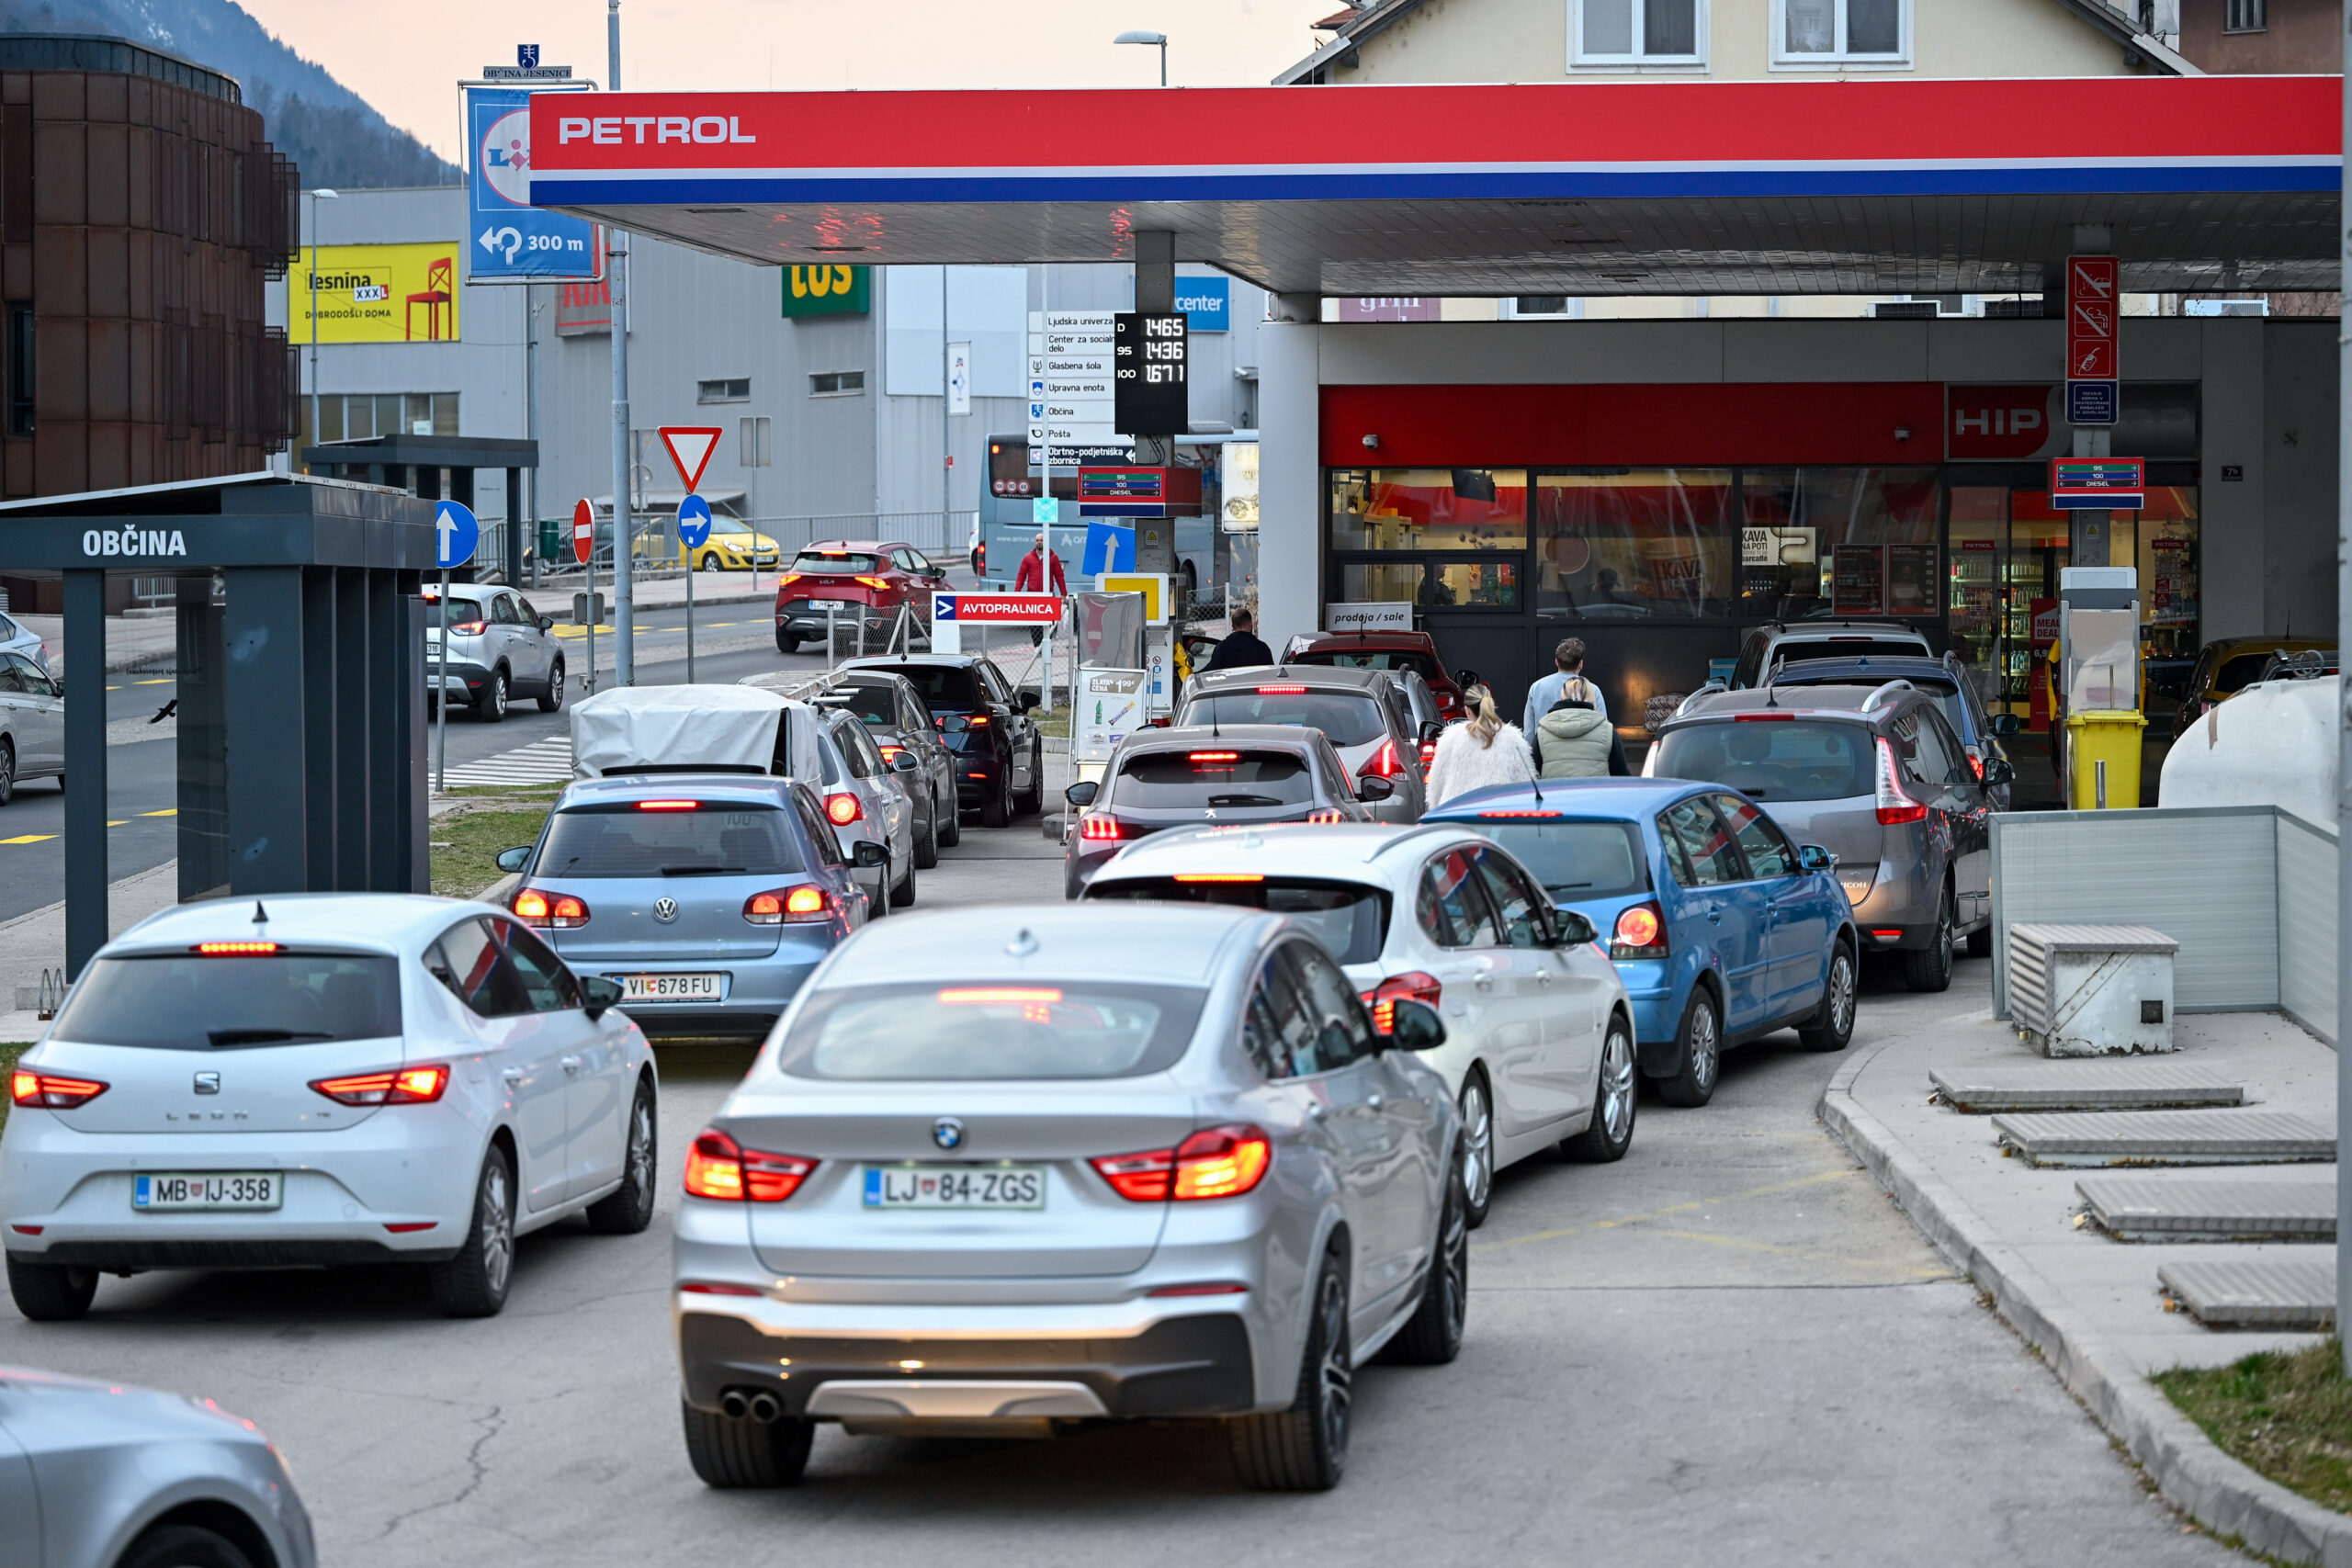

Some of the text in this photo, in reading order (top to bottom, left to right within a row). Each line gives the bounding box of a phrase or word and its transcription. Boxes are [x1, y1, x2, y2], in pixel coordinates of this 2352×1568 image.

[524, 69, 571, 78] JESENICE
[560, 117, 756, 144] PETROL
[528, 235, 583, 251] 300 m
[309, 272, 371, 289] lesnina
[356, 287, 388, 299] XXXL
[1175, 295, 1224, 311] center
[365, 309, 391, 318] DOMA
[1048, 317, 1114, 327] Ljudska univerza
[1117, 323, 1125, 332] D
[1048, 334, 1074, 344] Center
[1090, 334, 1115, 344] socialn
[1048, 344, 1064, 353] delo
[1117, 346, 1132, 355] 95
[1048, 361, 1102, 370] Glasbena šola
[1117, 369, 1136, 378] 100
[1048, 383, 1105, 393] Upravna enota
[1048, 407, 1074, 416] Občina
[1955, 409, 2041, 435] HIP
[1048, 429, 1071, 438] Pošta
[1048, 446, 1124, 457] Obrtno-podjetniška
[1048, 456, 1081, 465] zbornica
[83, 525, 187, 557] OBČINA
[996, 535, 1035, 543] www.arriva.s
[1742, 530, 1768, 542] KAVA
[1752, 542, 1768, 550] POTI
[962, 603, 1054, 615] AVTOPRALNICA
[1335, 613, 1374, 625] prodaja
[1384, 612, 1404, 622] sale
[2037, 618, 2060, 627] MEAL
[2037, 629, 2059, 637] DEAL
[427, 645, 438, 653] 316
[2034, 649, 2048, 659] 6,9
[629, 979, 645, 995] VI
[156, 1179, 270, 1201] MB IJ-358
[885, 1173, 1038, 1202] LJ 84-ZGS
